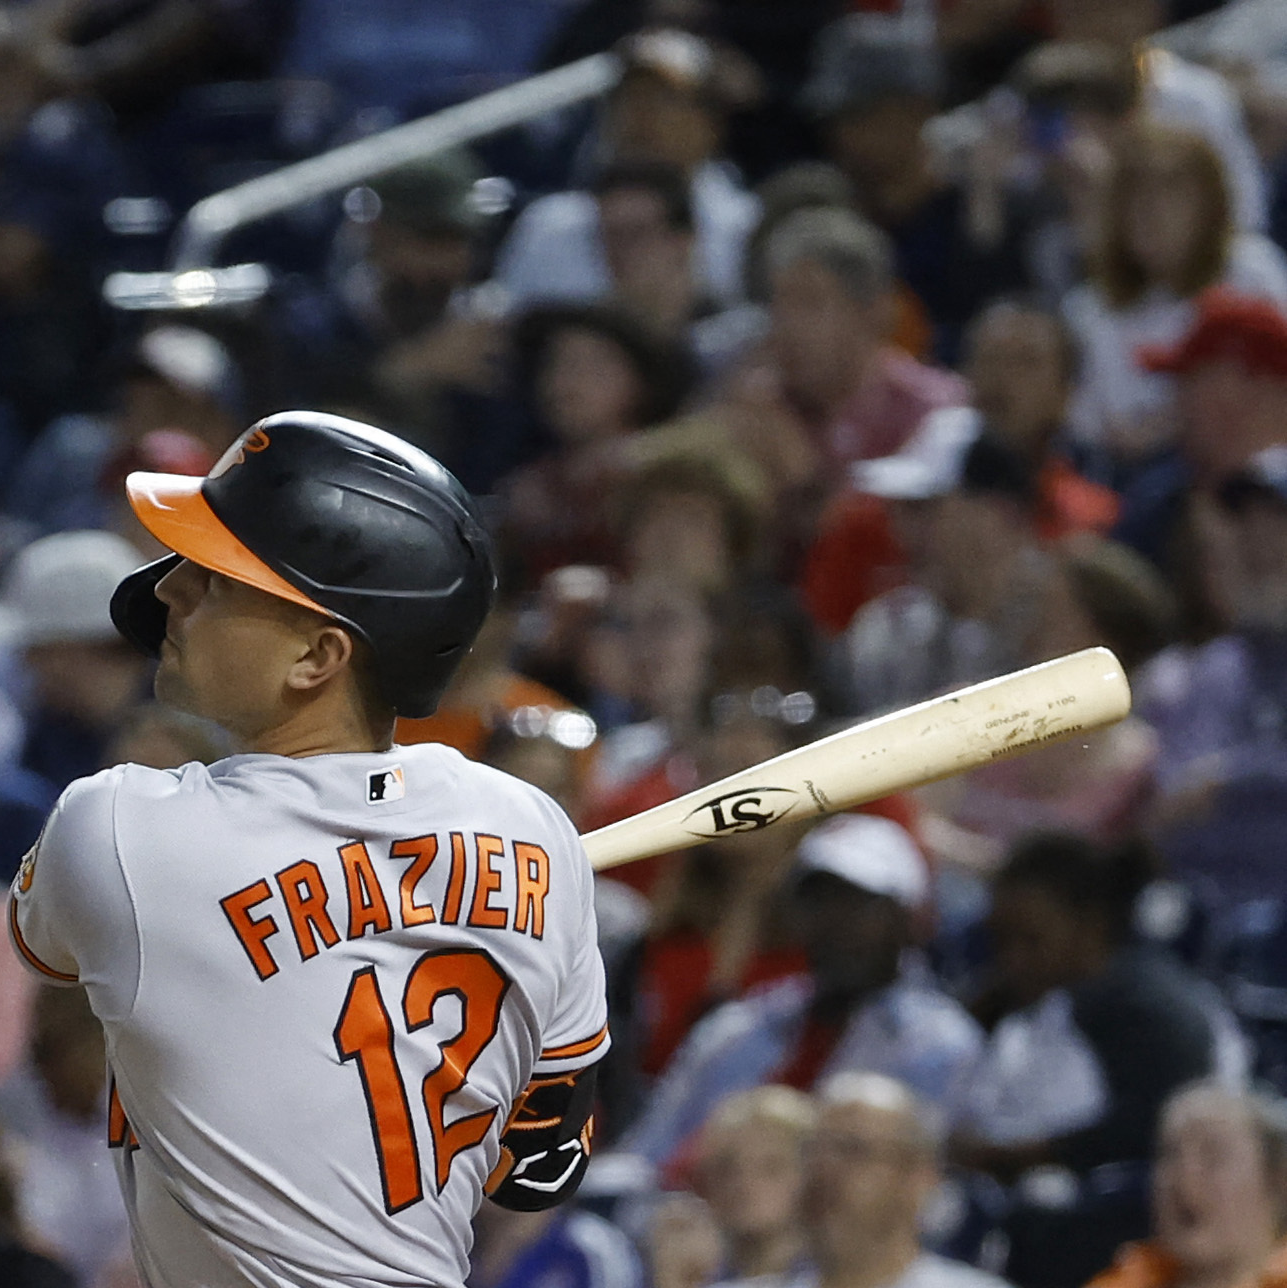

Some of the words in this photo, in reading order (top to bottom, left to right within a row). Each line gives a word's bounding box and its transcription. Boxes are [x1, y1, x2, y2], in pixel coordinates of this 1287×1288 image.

[710, 797, 774, 833] LS
[219, 831, 550, 982] FRAZIER
[333, 947, 513, 1216] 12
